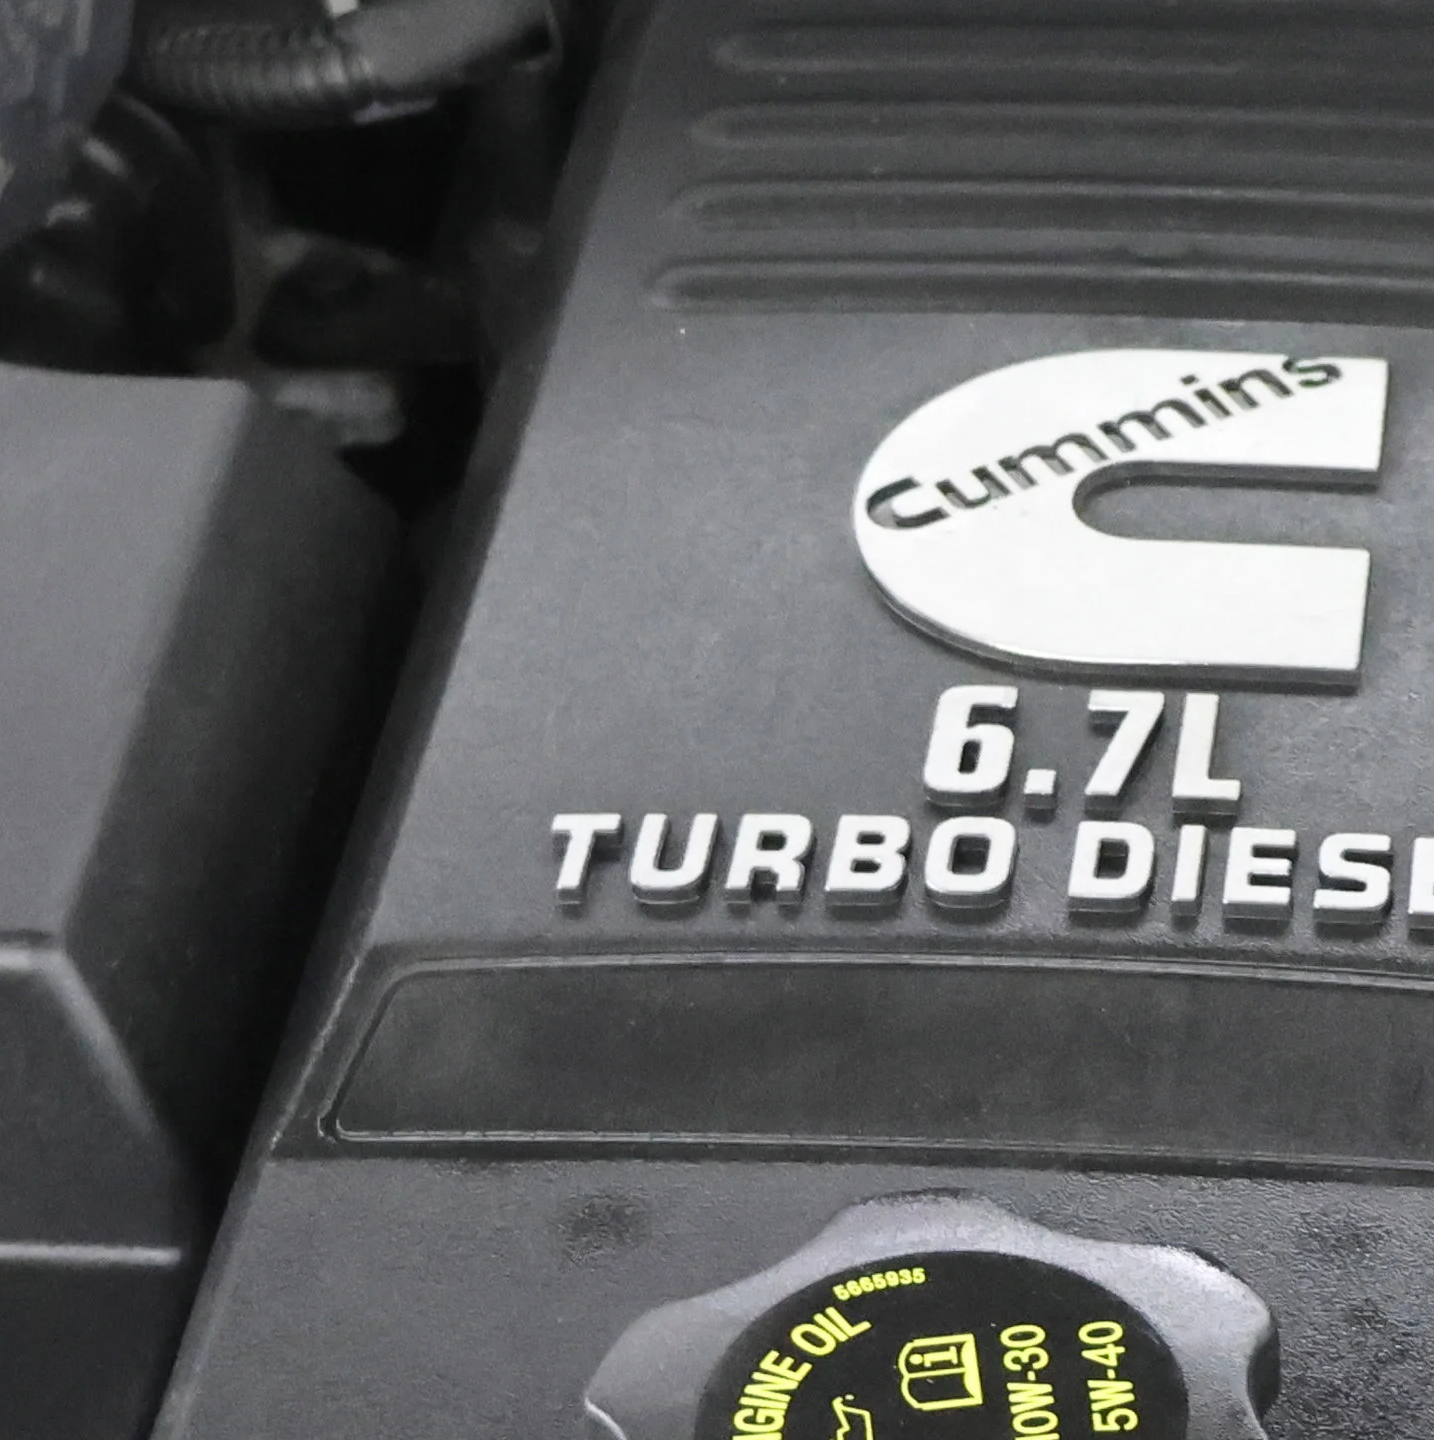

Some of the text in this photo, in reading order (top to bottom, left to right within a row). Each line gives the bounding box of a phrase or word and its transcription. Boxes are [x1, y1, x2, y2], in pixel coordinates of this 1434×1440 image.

[866, 355, 1344, 531] Cummins
[922, 684, 1243, 814] 6.7L
[551, 812, 1020, 910] TURBO
[790, 1306, 872, 1357] OIL
[832, 1267, 926, 1302] 5665935
[1077, 1320, 1139, 1432] 5W-40
